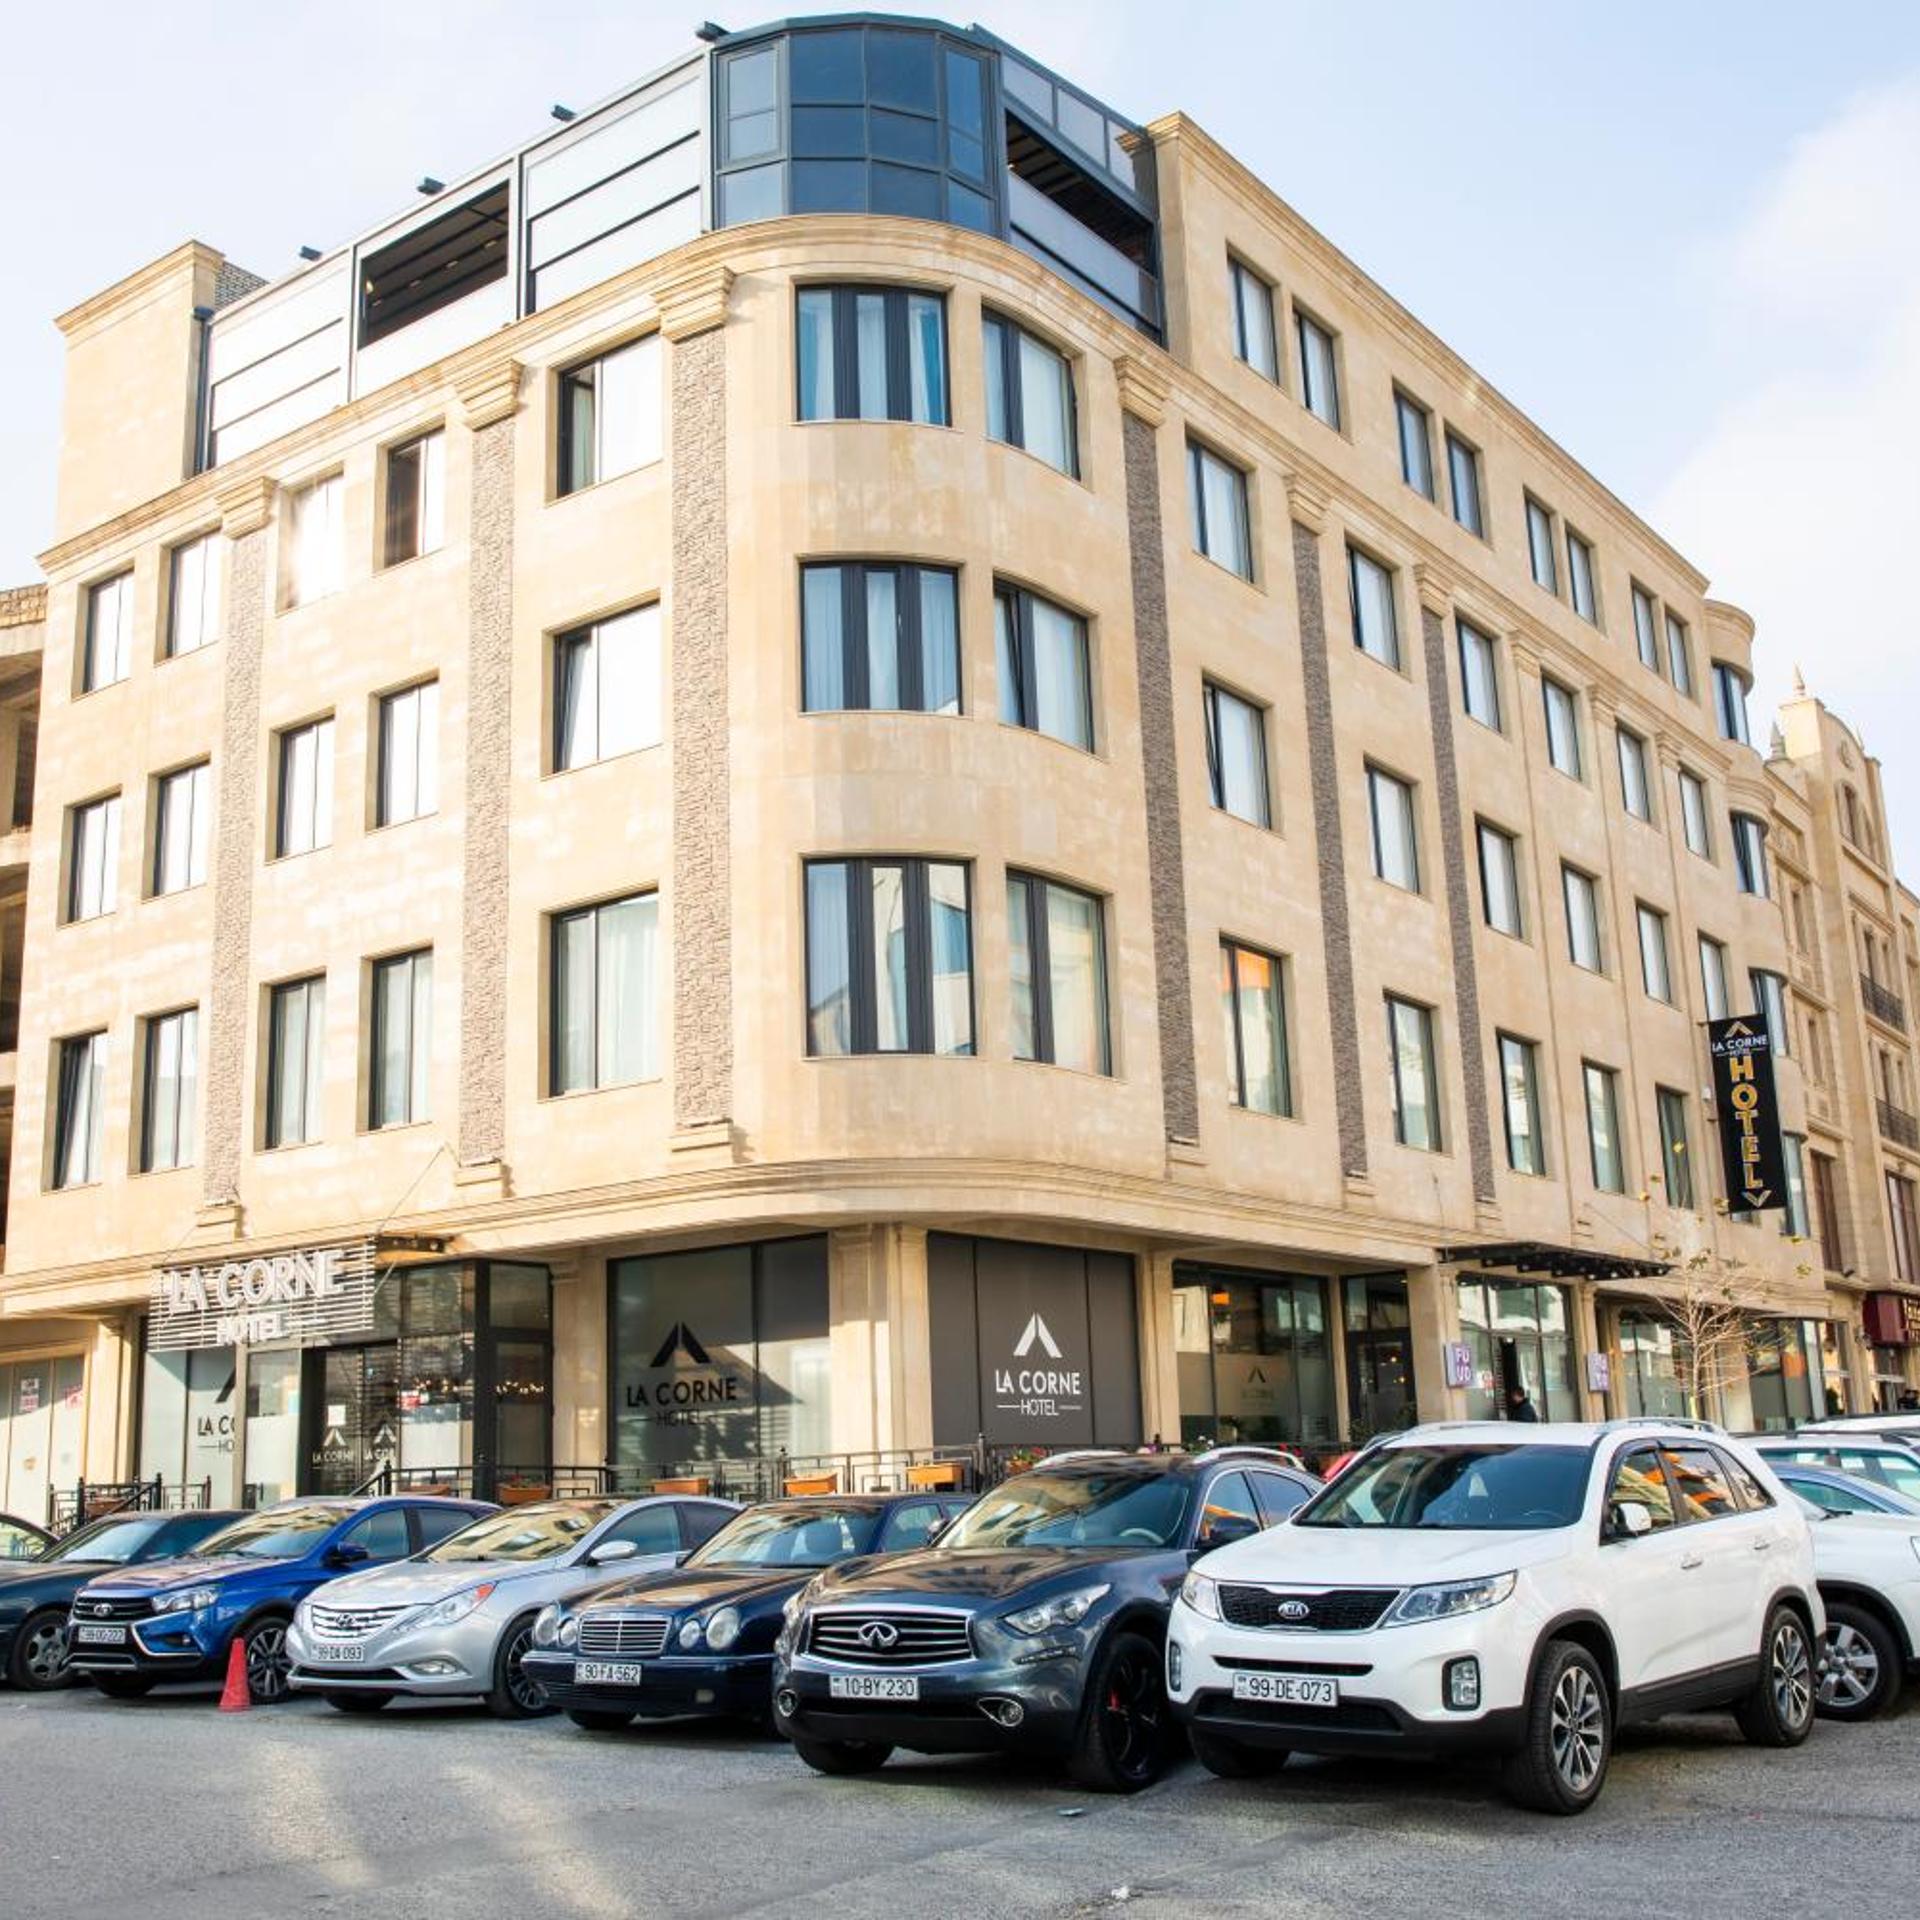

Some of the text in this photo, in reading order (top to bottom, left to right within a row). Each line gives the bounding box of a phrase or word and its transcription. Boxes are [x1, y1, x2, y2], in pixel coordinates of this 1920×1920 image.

[1712, 1034, 1768, 1051] LA CORNE
[1729, 1056, 1764, 1189] HOTEL
[168, 1250, 345, 1313] LA CORNE
[215, 1312, 288, 1345] HOTEL
[627, 1377, 737, 1408] LA CORNE
[995, 1369, 1082, 1395] LA CORNE
[1020, 1399, 1060, 1416] HOTEL
[197, 1414, 214, 1436] LA
[845, 1677, 915, 1697] 10-BY-230
[1249, 1677, 1332, 1702] 99-DE-073
